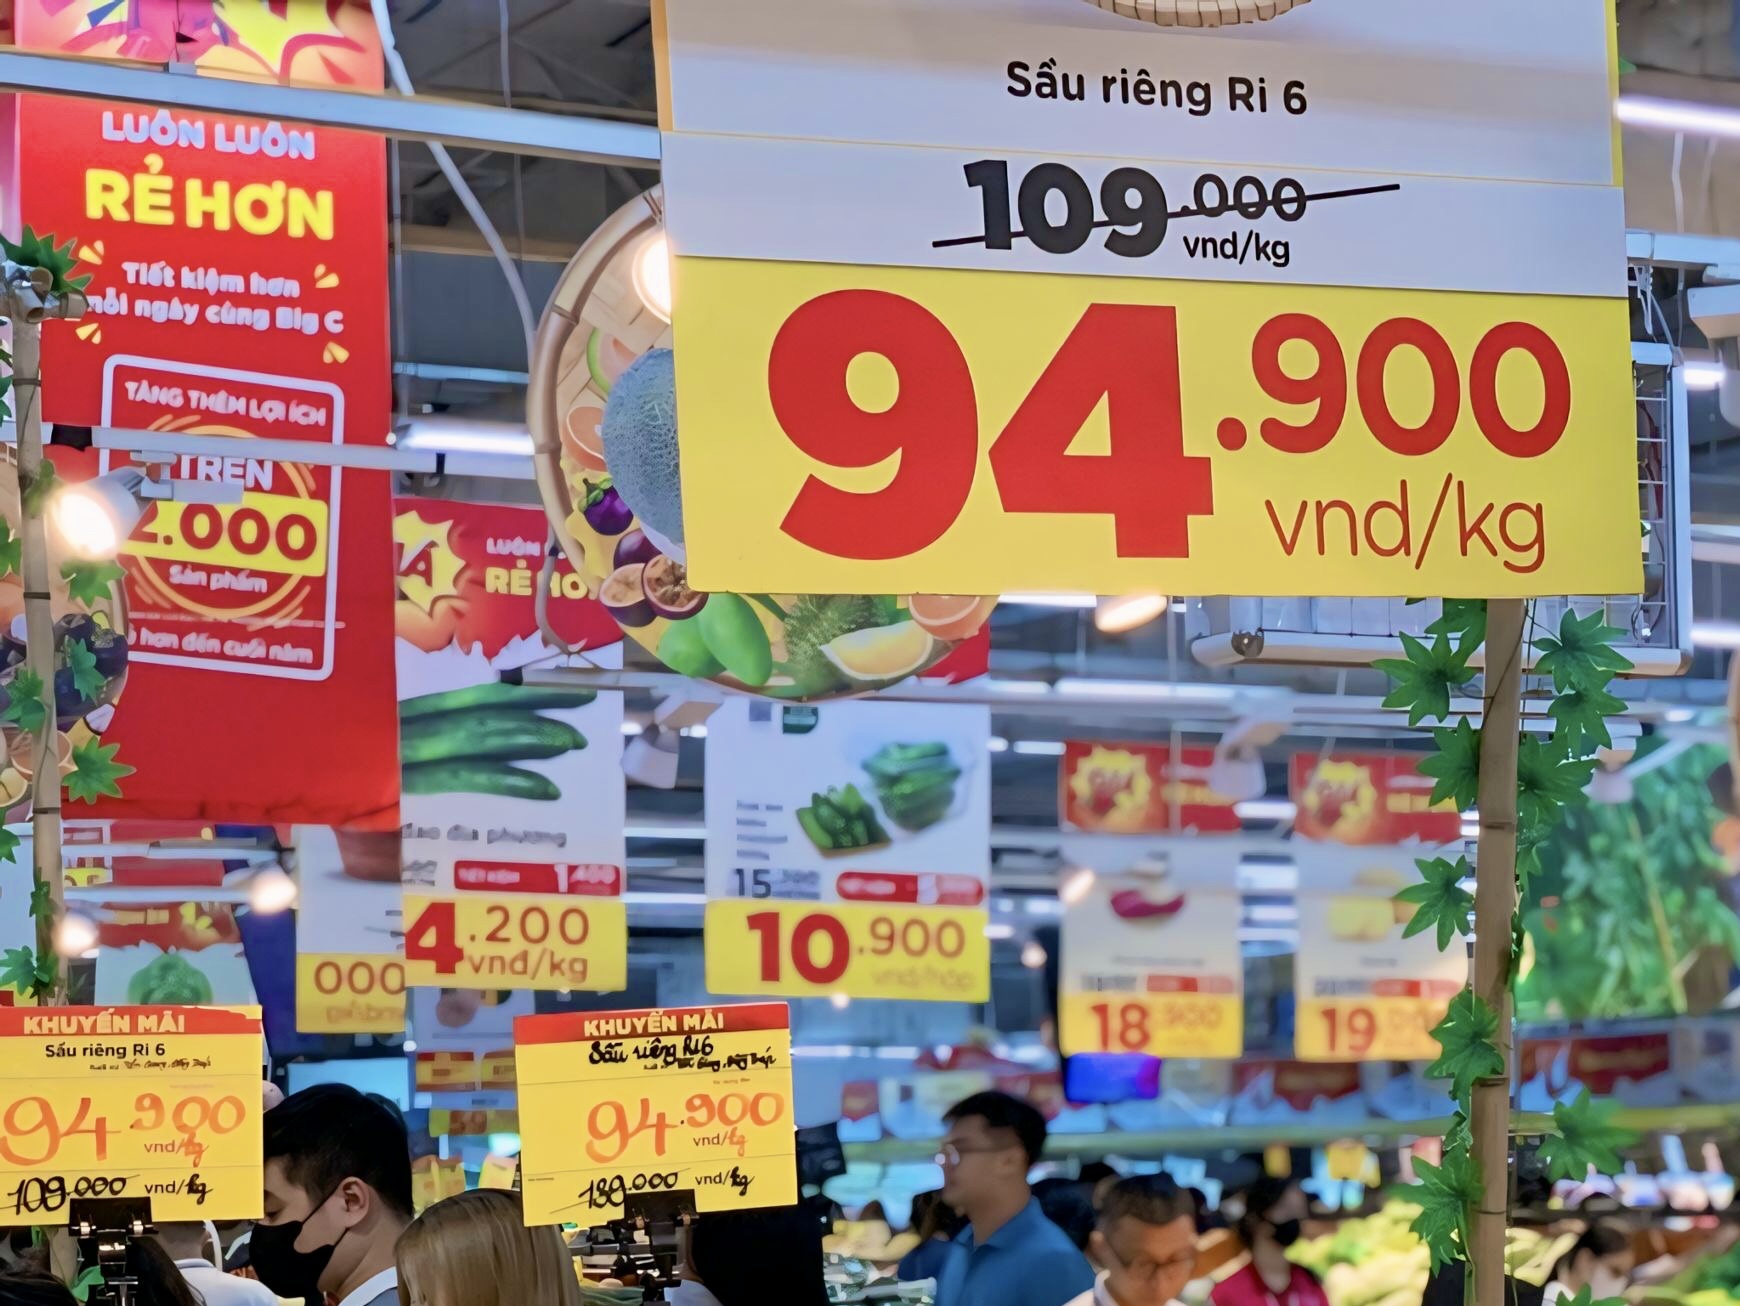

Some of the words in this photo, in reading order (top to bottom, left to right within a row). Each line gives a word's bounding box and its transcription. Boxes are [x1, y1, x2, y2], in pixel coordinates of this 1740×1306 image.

[1006, 56, 1086, 102] Sầu
[1101, 67, 1213, 117] riêng
[1228, 76, 1267, 113] Ri
[1283, 80, 1308, 115] 6
[102, 109, 205, 149] LUÔN
[214, 121, 315, 160] LUÔN
[85, 153, 175, 225] RẺ
[185, 178, 334, 240] HƠN
[1182, 230, 1290, 268] vnd/kg
[121, 261, 176, 288] Tiết
[249, 272, 301, 298] hơn
[275, 306, 319, 335] Big
[323, 310, 344, 334] C
[1265, 475, 1546, 574] vnd/kg
[210, 568, 268, 593] phẩm
[467, 947, 589, 985] vnd/kg
[23, 1008, 131, 1035] KHUYẾN
[137, 1010, 186, 1035] MÃI
[584, 1009, 678, 1037] KHUYẾN
[682, 1008, 725, 1031] MÃI
[82, 1043, 127, 1060] riêng
[155, 1042, 166, 1057] 6
